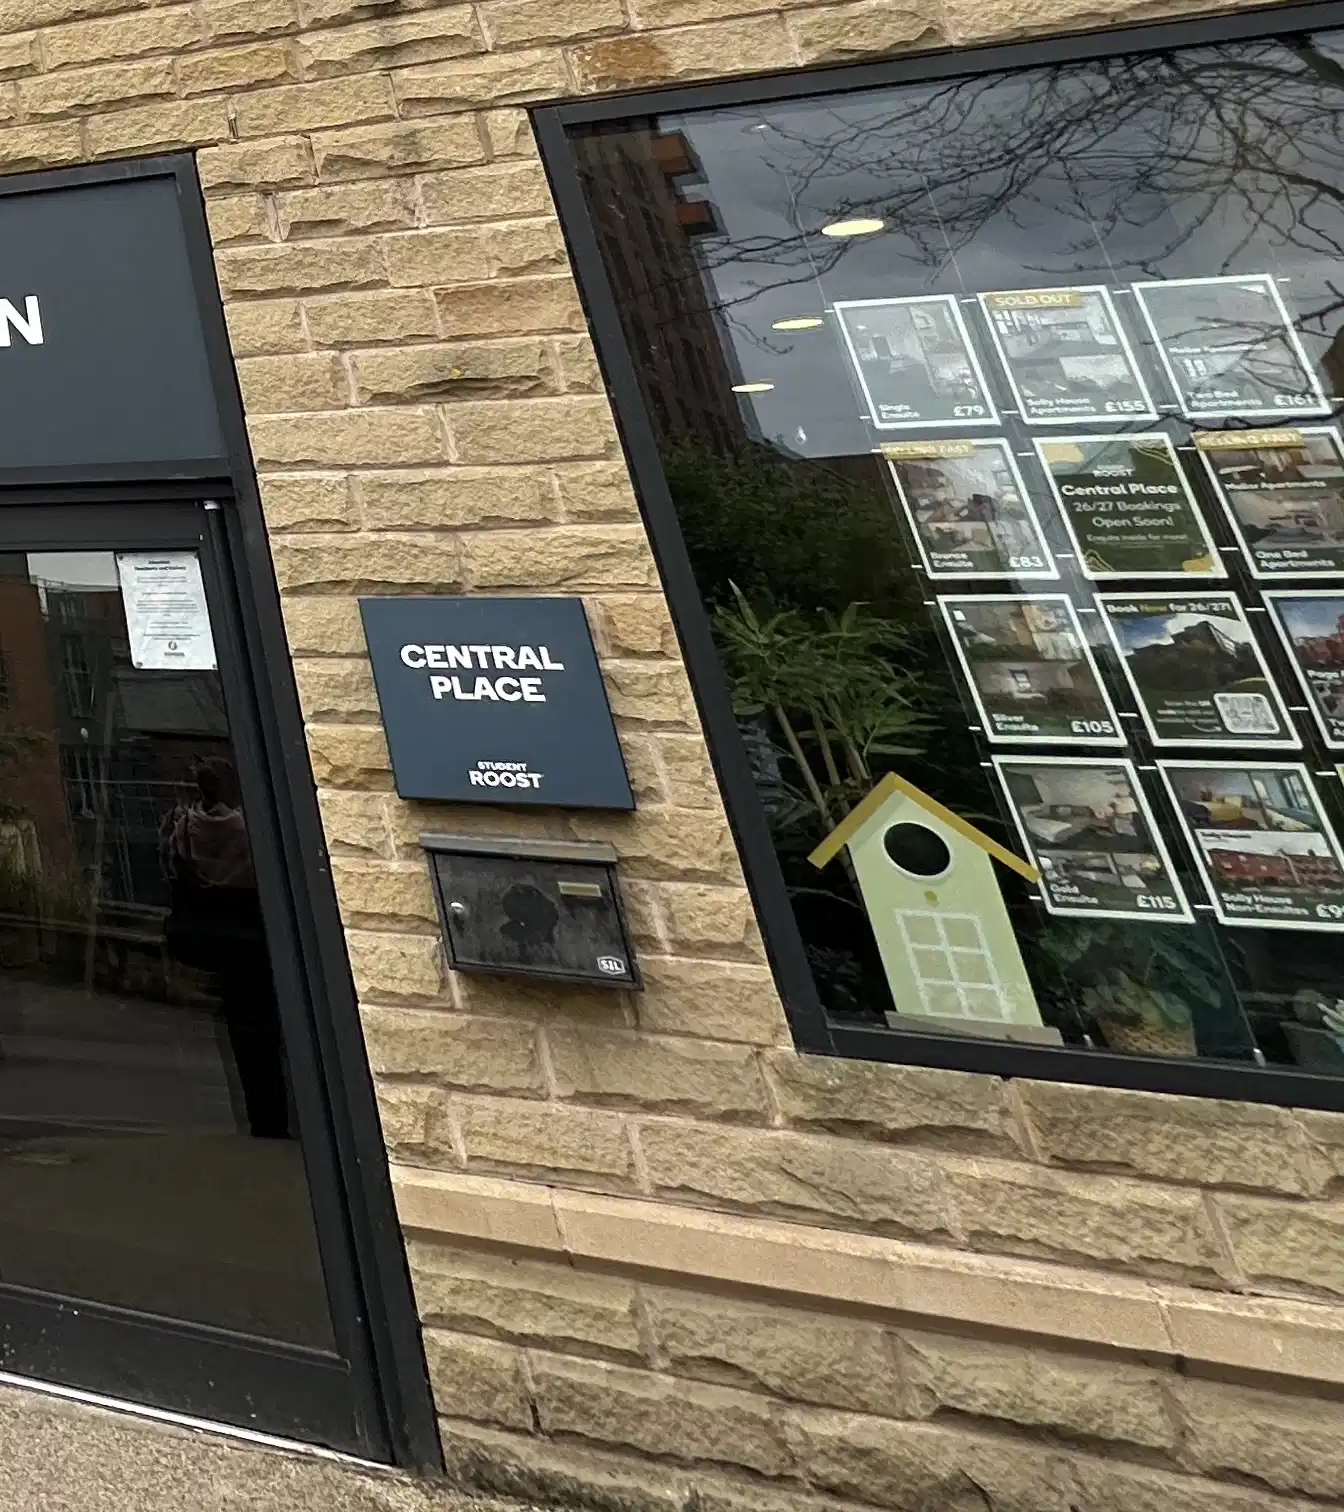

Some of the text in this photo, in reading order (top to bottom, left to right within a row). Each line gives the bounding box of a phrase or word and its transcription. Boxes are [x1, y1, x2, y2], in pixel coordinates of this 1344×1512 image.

[995, 294, 1073, 307] SOLD OUT
[953, 405, 985, 417] £79
[1104, 400, 1146, 412] £155
[1061, 483, 1179, 496] Central Place
[1072, 501, 1181, 513] 26/27 Bookings
[1092, 516, 1174, 528] Open Soon!
[1009, 556, 1044, 568] £83
[400, 644, 565, 671] CENTRAL
[429, 675, 547, 702] PLACE
[1071, 720, 1114, 733] £105
[477, 760, 528, 772] STUDENT
[468, 770, 542, 789] ROOST
[1136, 894, 1178, 909] £115
[1316, 903, 1344, 919] £9
